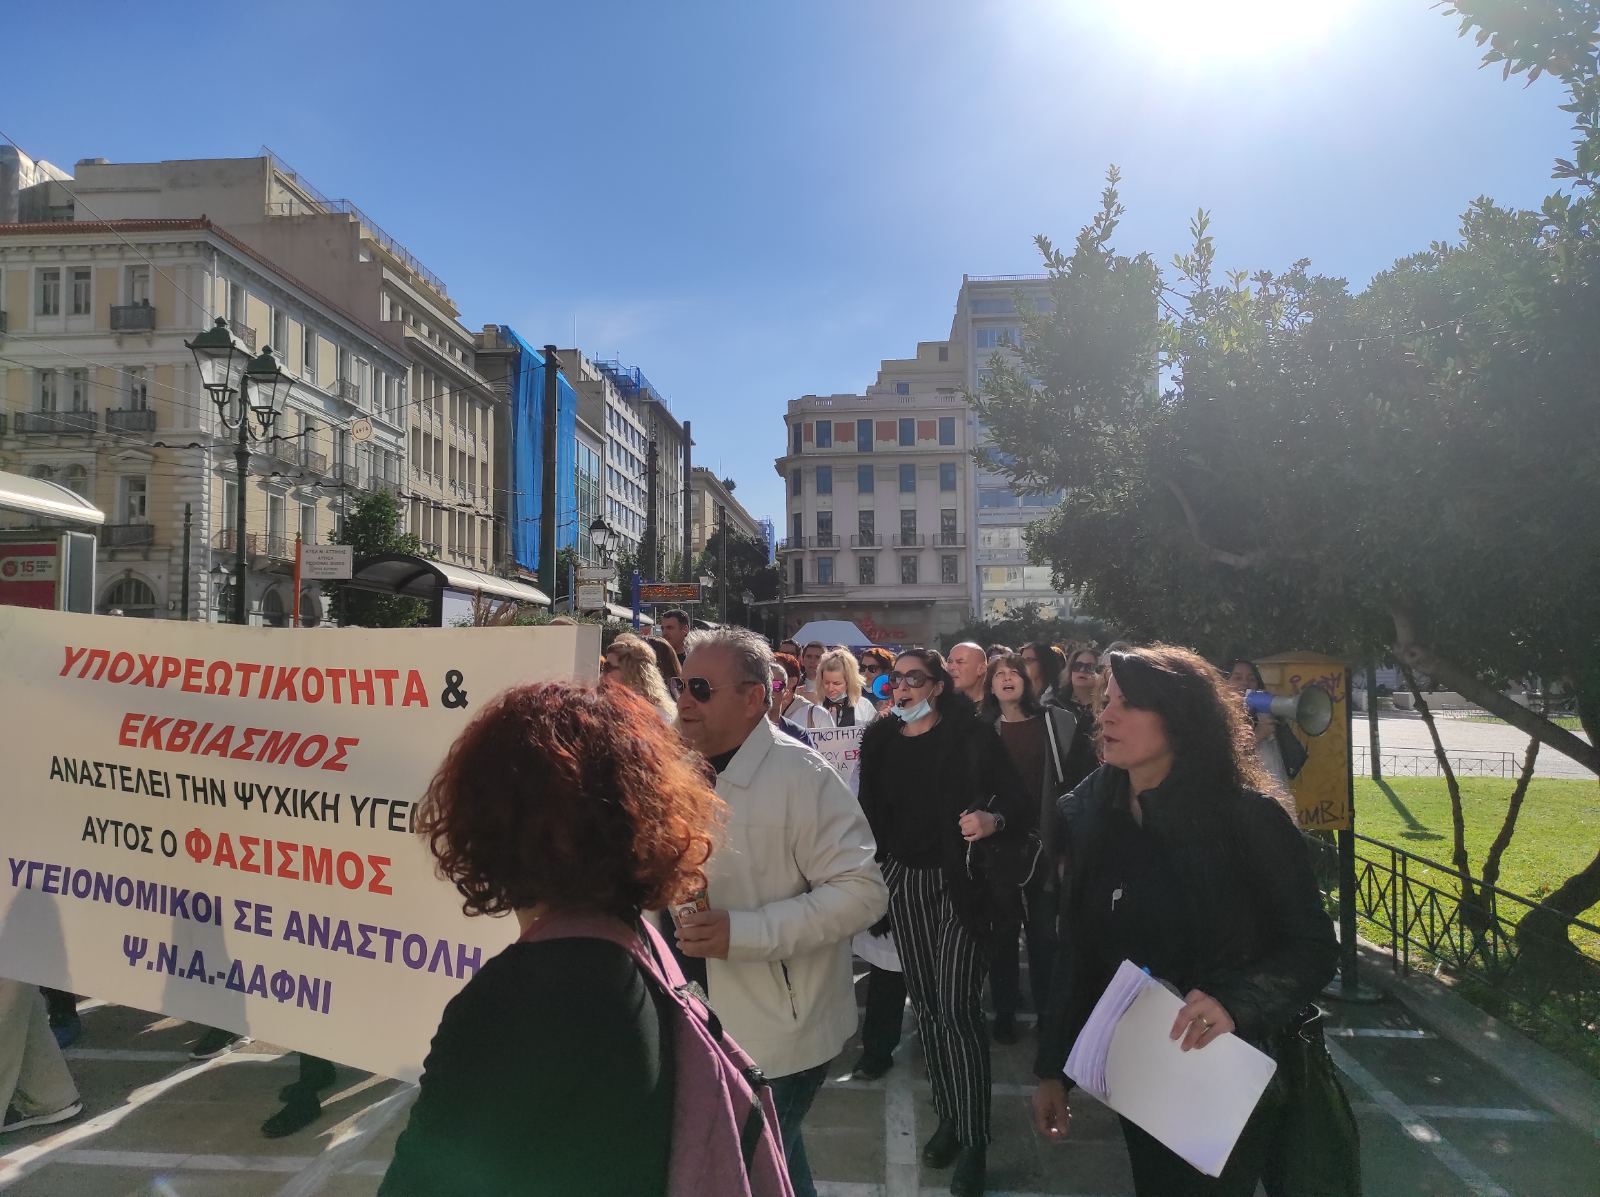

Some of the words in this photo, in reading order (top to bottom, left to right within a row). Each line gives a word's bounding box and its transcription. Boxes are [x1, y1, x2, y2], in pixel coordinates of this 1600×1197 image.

[59, 646, 429, 708] ΥΠΟΧΡΕΩΤΙΚΟΤΗΤΑ
[441, 669, 469, 709] &
[119, 712, 360, 772] ΕΚΒΙΑΣΜΟΣ
[50, 755, 171, 799] ΑΝΑΣΤΕΛΕΙ
[175, 773, 227, 808] ΤΗΝ
[233, 781, 340, 824] ΨΥΧΙΚΗ
[81, 815, 154, 854] ΑΥΤΟΣ
[160, 829, 178, 858] Ο
[184, 827, 393, 896] ΦΑΣΙΣΜΟΣ
[8, 857, 222, 926] ΥΓΕΙΟΝΟΜΙΚΟΙ
[233, 899, 273, 938] ΣΕ
[282, 910, 482, 980] ΑΝΑΣΤΟΛΗ
